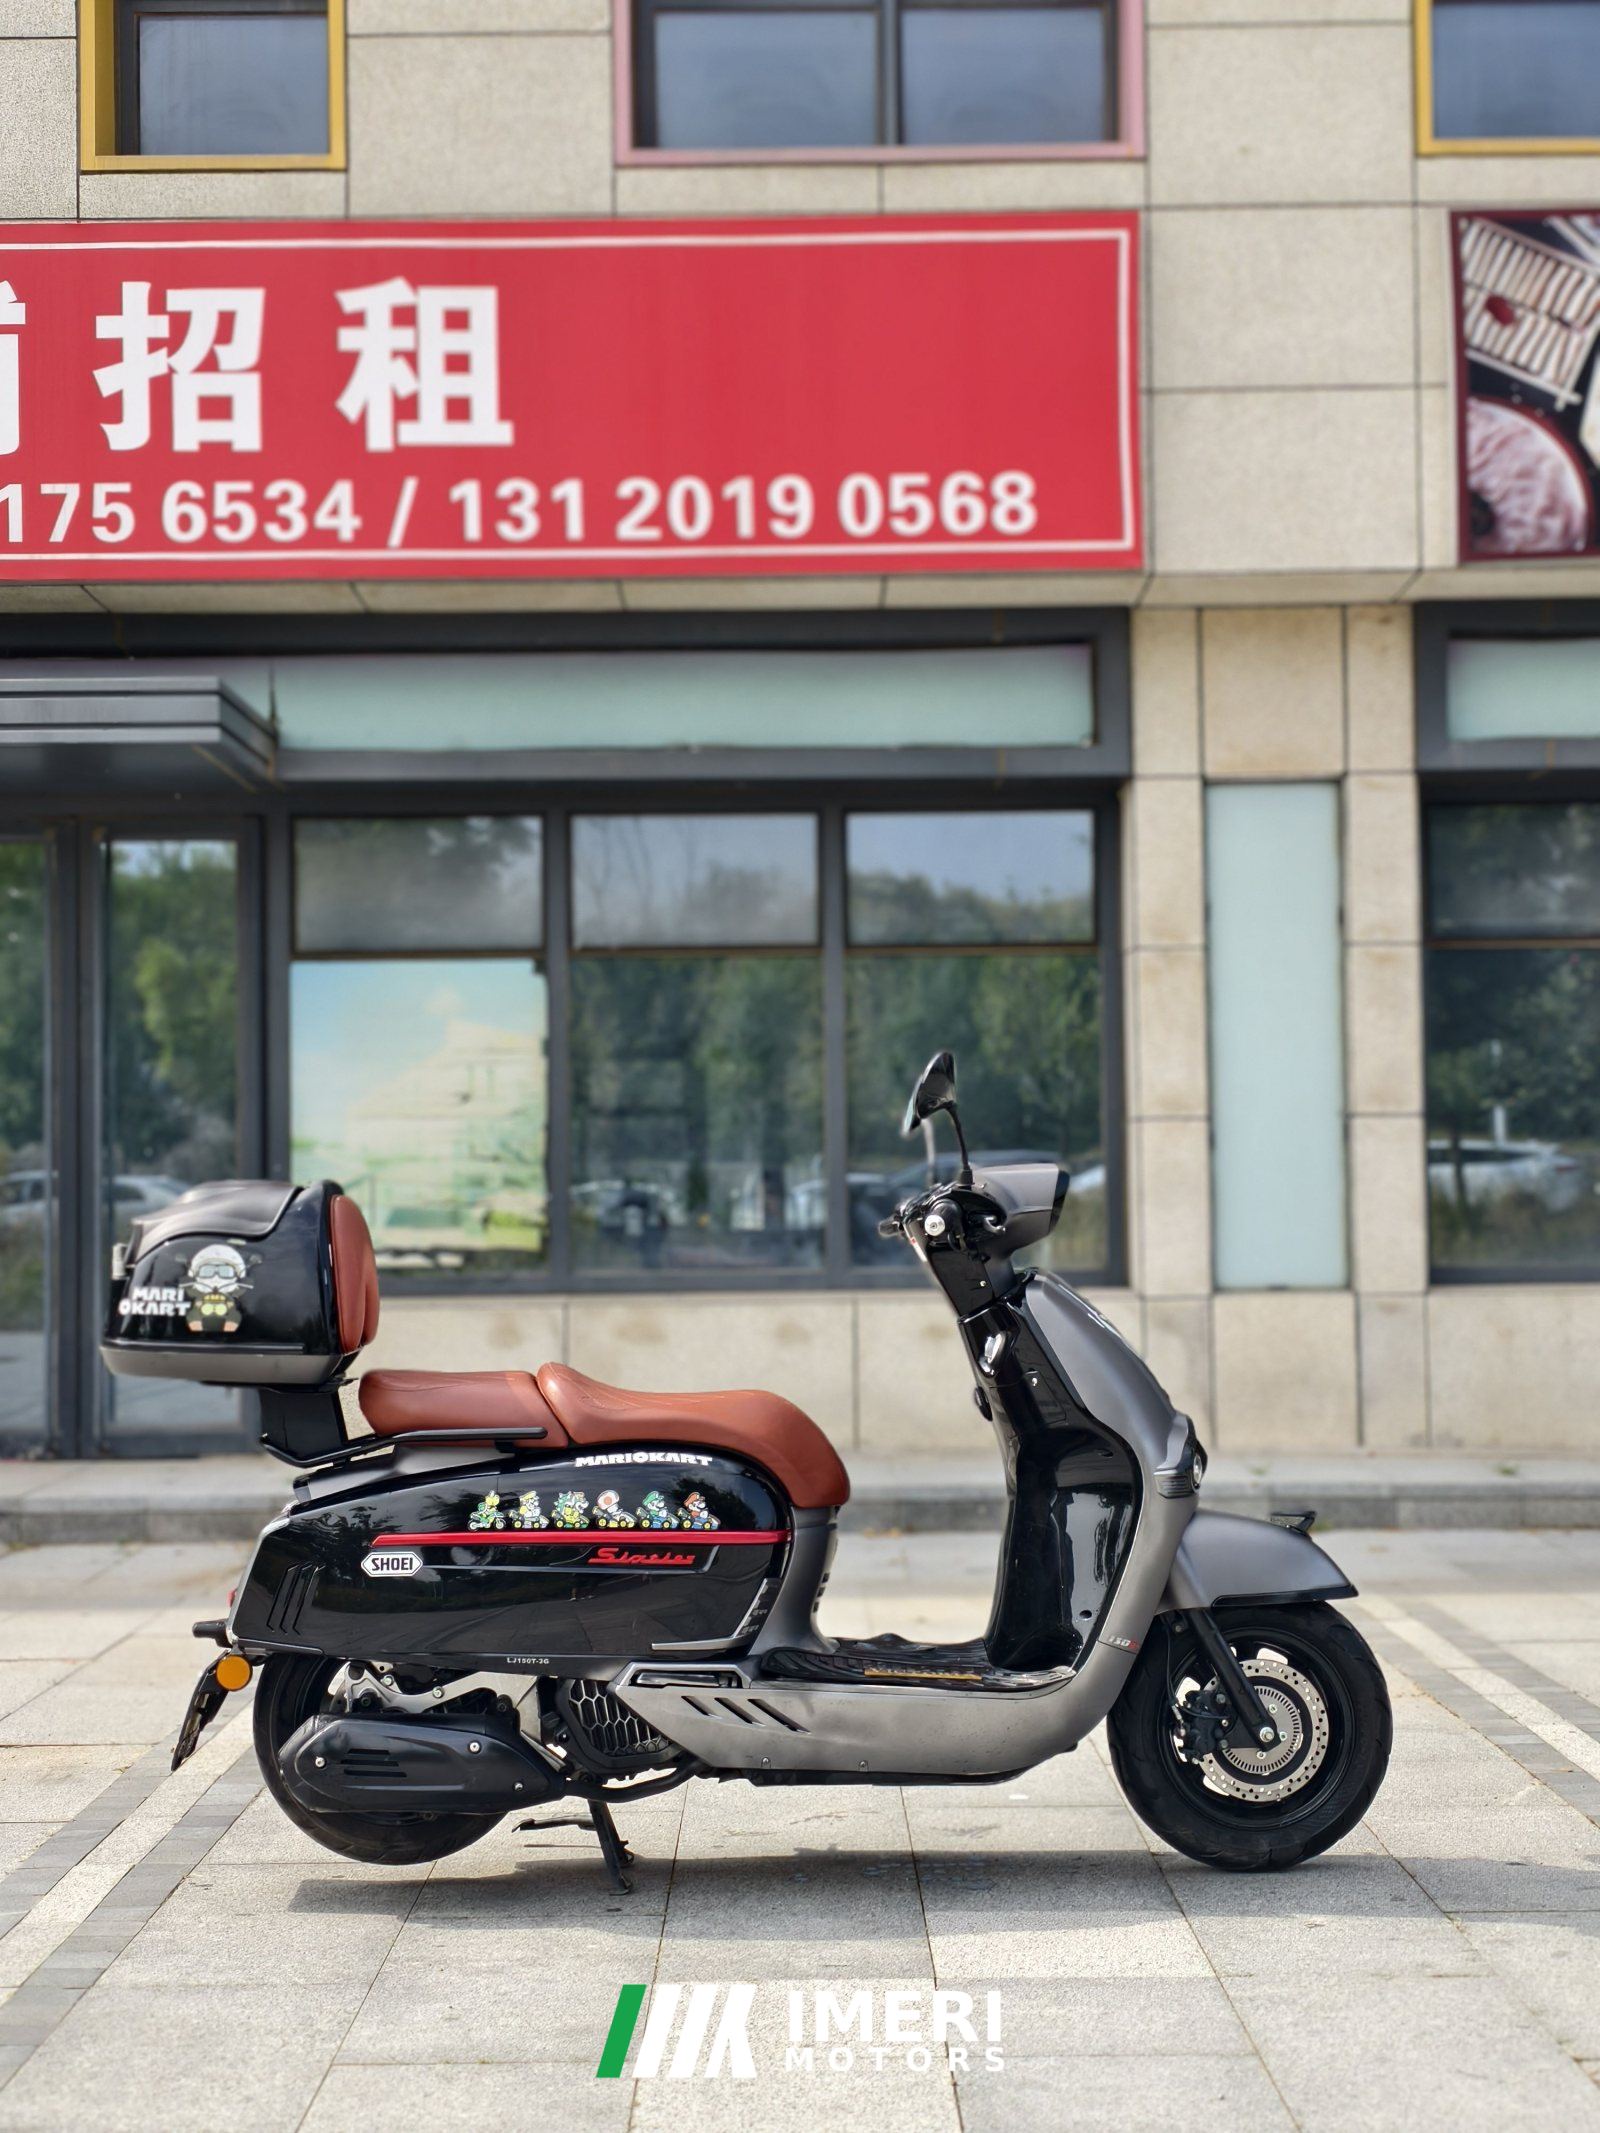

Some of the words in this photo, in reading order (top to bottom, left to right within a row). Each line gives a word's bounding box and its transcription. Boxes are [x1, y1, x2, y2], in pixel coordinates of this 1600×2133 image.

[0, 277, 513, 453] 招租
[0, 482, 136, 543] 175
[161, 480, 361, 543] 6534
[388, 477, 418, 549] /
[449, 478, 584, 542] 131
[615, 474, 814, 541] 2019
[837, 470, 1038, 538] 0568
[132, 1287, 184, 1301] MARI
[119, 1298, 191, 1316] OKART
[371, 1557, 413, 1571] SHOEI
